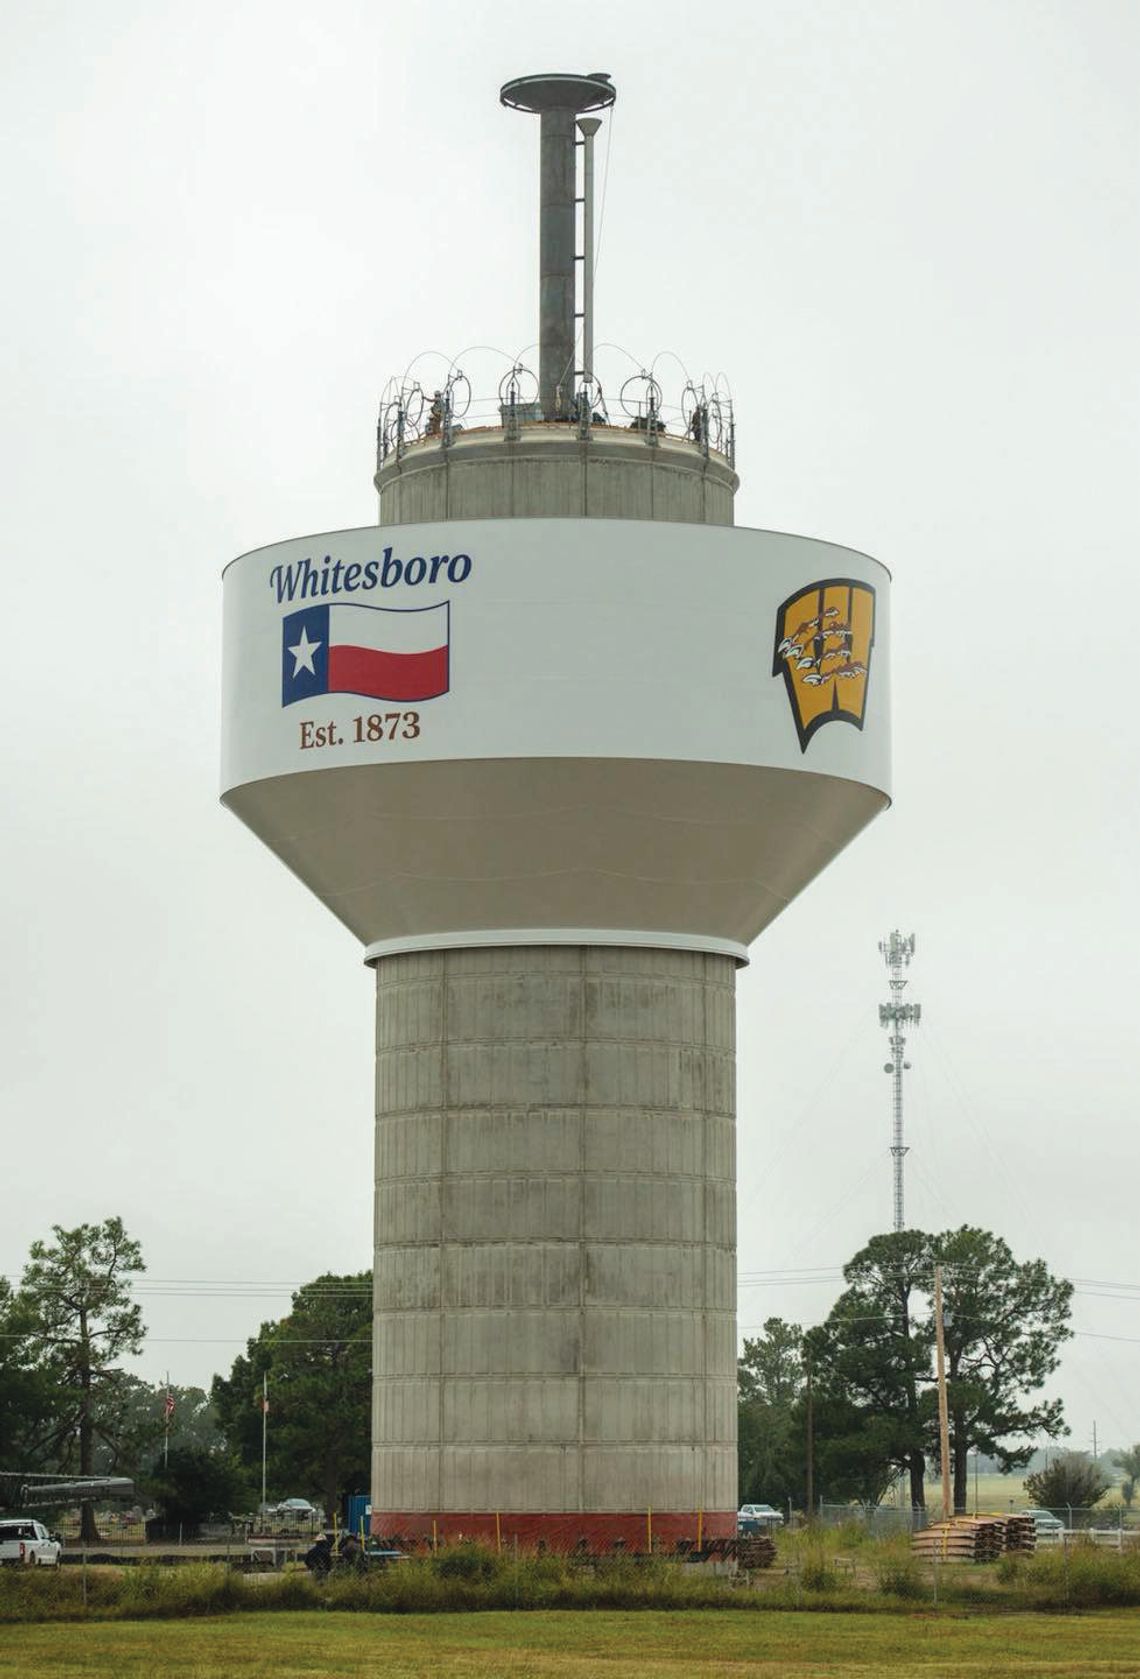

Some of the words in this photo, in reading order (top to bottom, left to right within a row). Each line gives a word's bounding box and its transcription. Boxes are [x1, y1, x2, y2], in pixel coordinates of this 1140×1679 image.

[270, 547, 472, 604] Whitesboro
[299, 721, 344, 750] Est.
[352, 711, 420, 743] 1873
